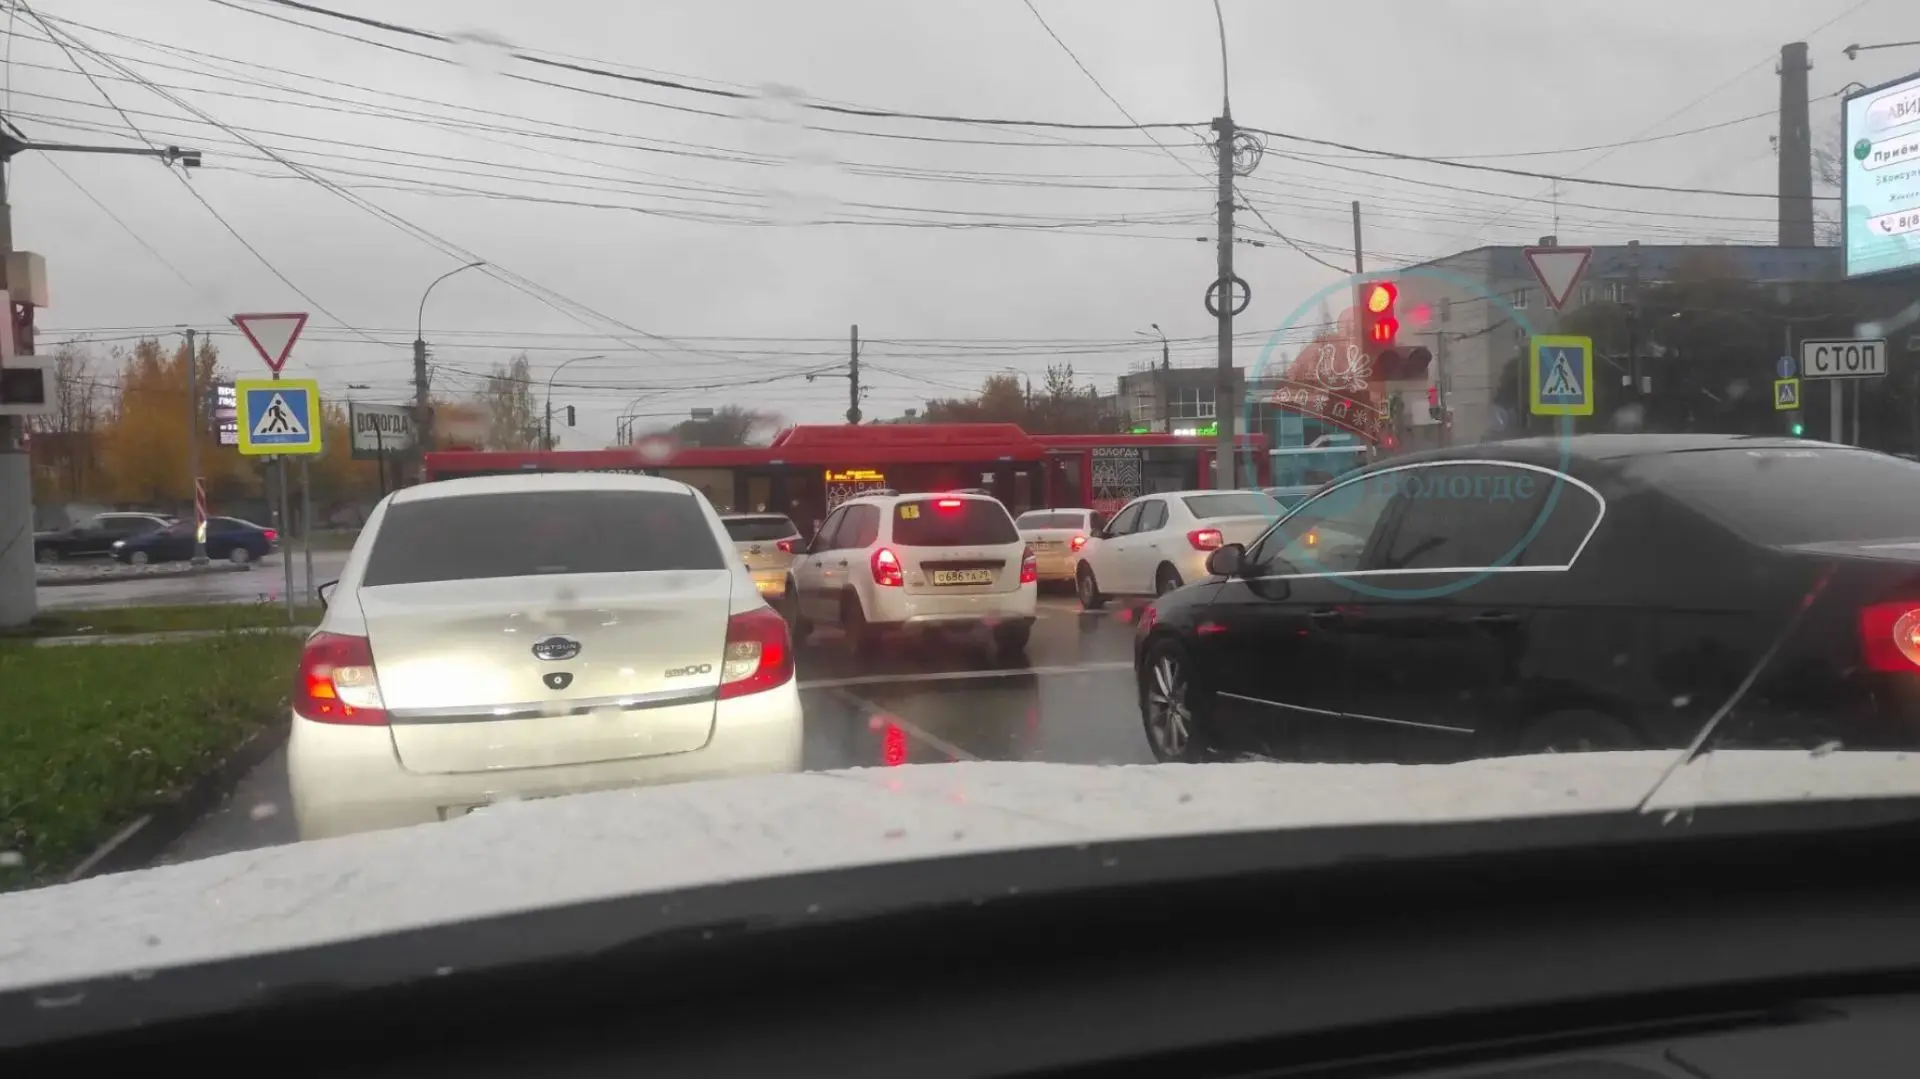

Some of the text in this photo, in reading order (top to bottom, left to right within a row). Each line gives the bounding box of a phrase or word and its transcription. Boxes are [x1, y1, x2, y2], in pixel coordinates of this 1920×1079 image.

[1874, 144, 1919, 161] Приём
[1815, 345, 1875, 371] СТОП
[1091, 447, 1140, 457] ВОЛОГДА
[536, 643, 577, 653] DATSUN
